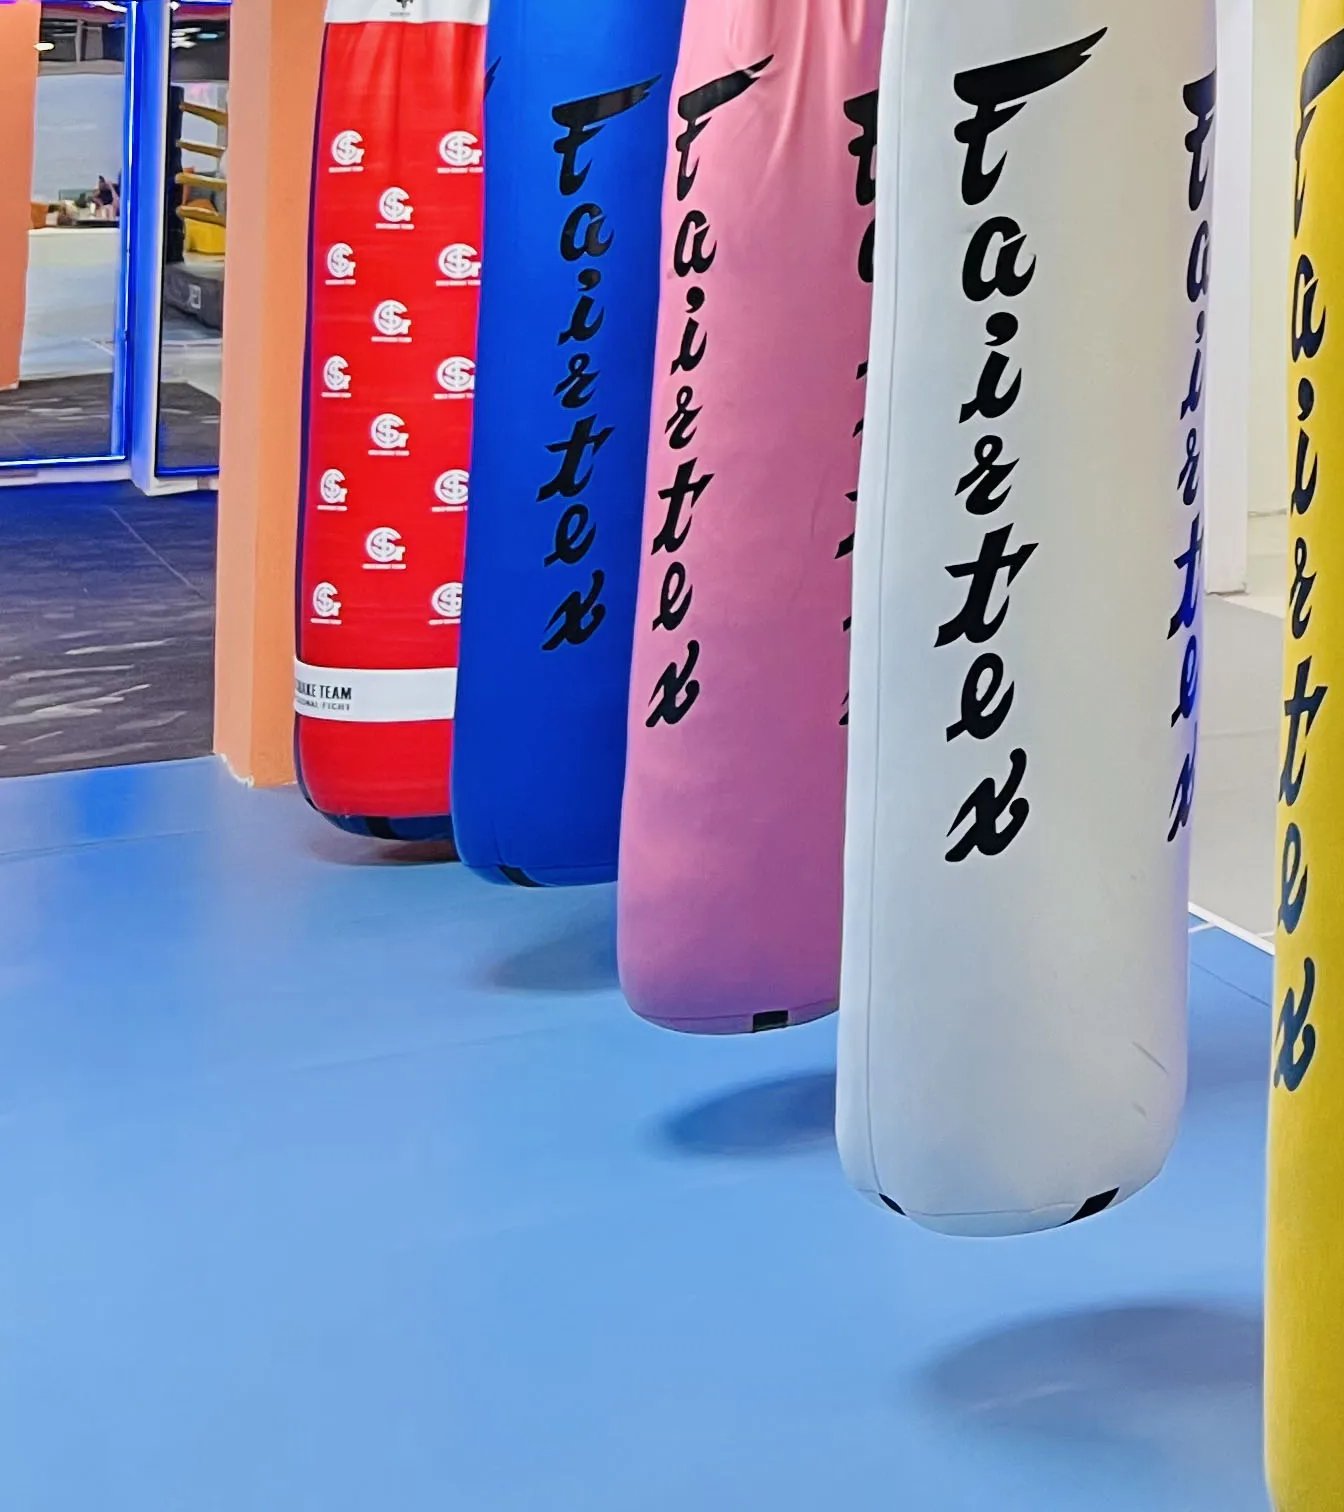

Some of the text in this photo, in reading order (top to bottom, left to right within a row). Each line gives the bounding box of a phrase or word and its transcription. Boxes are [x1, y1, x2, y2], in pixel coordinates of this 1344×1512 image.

[536, 74, 662, 650] Fairtex
[645, 54, 774, 728] Fairtex
[933, 26, 1109, 864] Fairtex
[320, 684, 352, 701] TEAM
